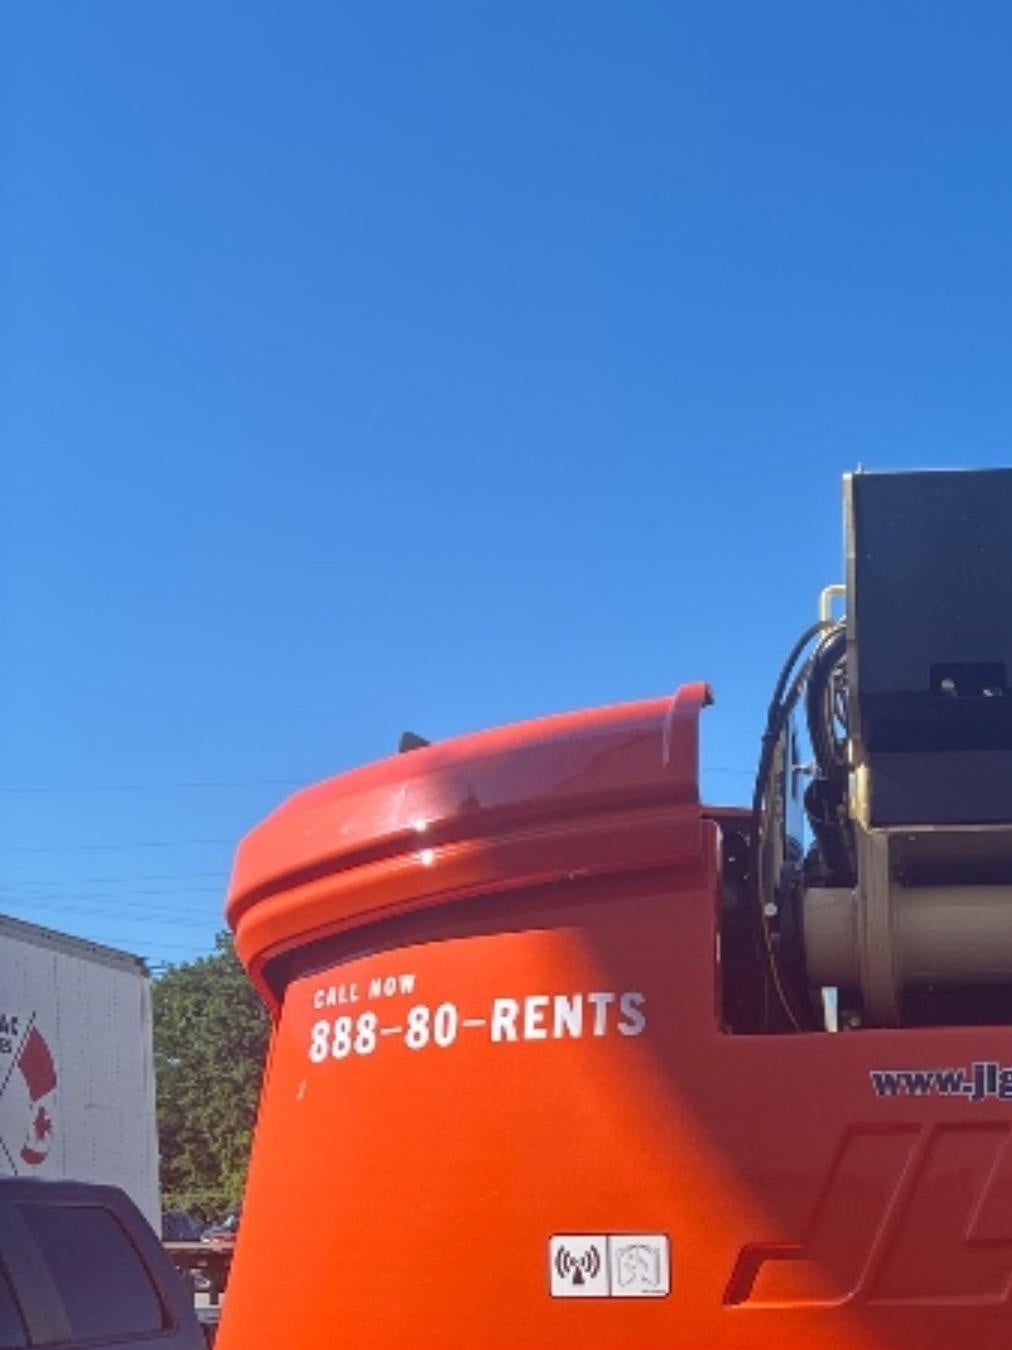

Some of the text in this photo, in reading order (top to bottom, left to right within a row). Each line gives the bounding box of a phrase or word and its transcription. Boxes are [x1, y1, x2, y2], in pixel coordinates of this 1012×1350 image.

[313, 974, 416, 1009] CALL NOW
[309, 992, 646, 1063] 888-80-RENTS
